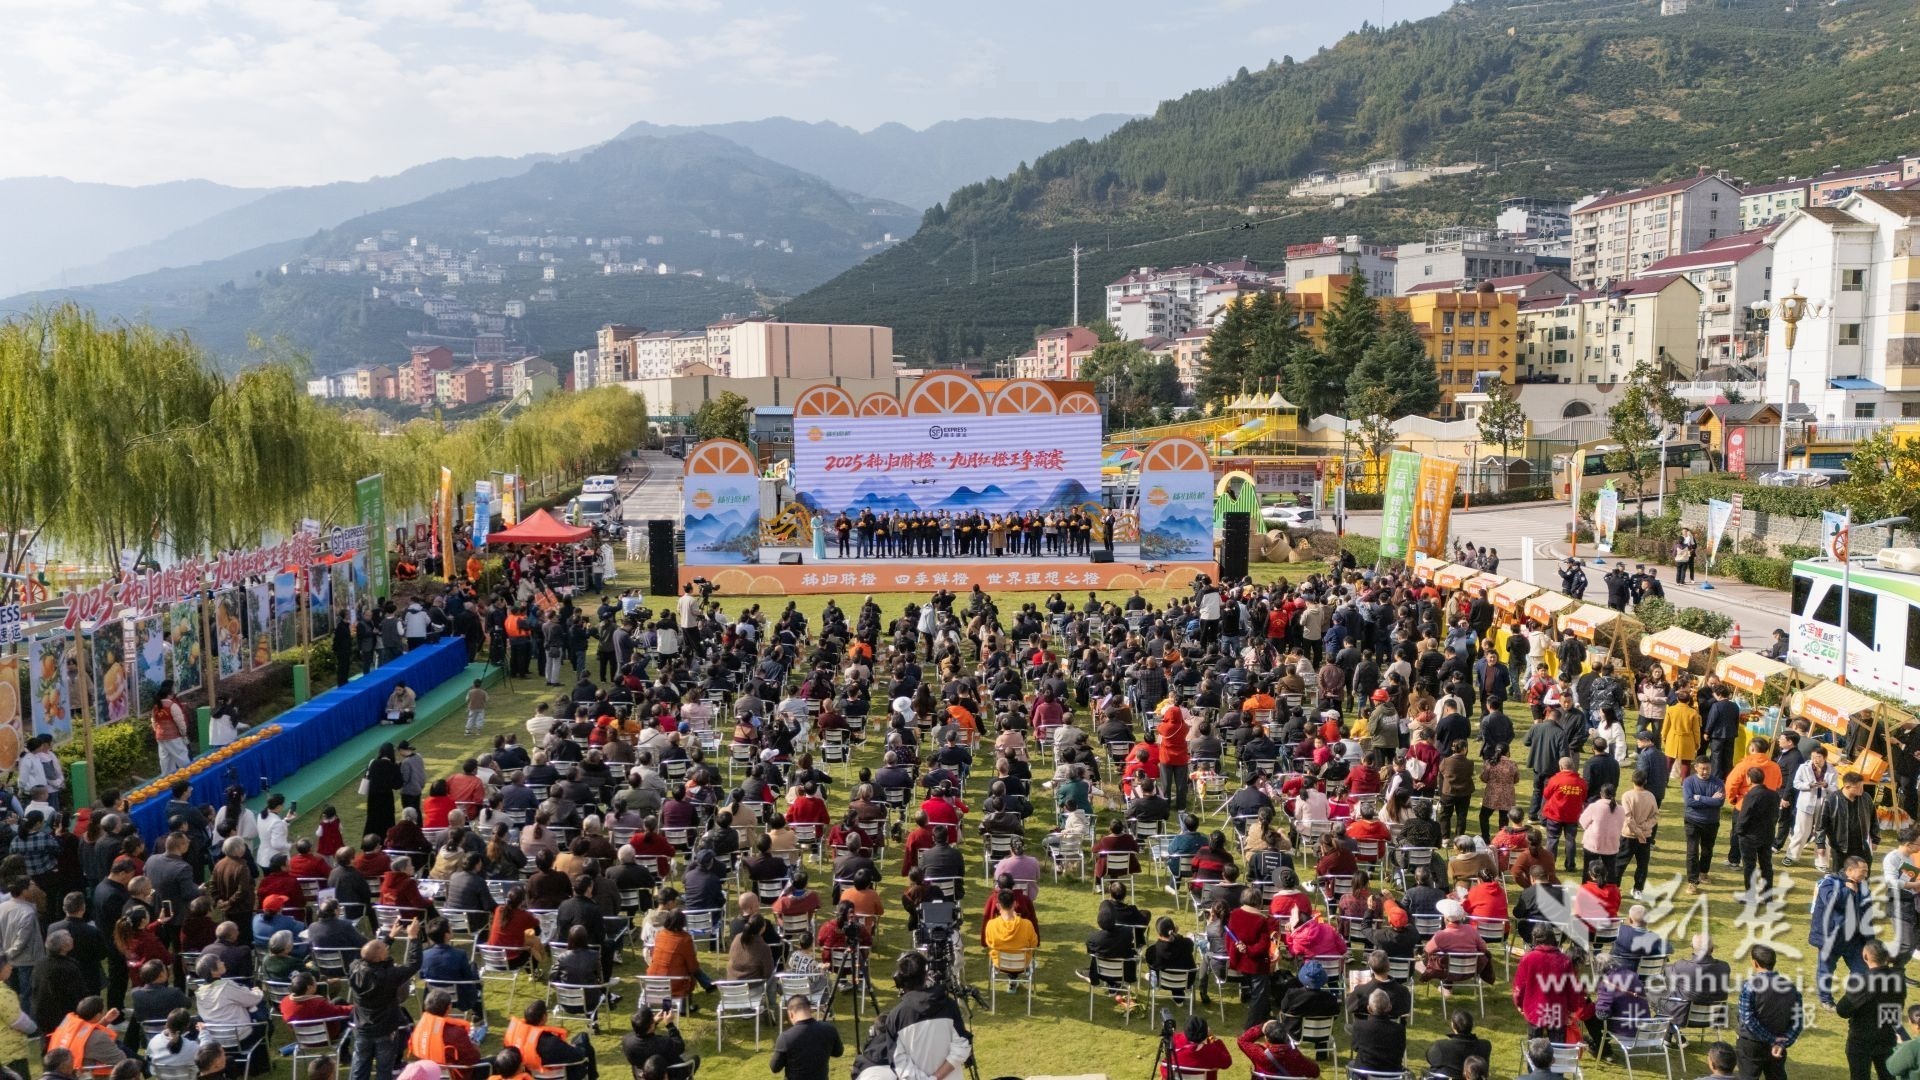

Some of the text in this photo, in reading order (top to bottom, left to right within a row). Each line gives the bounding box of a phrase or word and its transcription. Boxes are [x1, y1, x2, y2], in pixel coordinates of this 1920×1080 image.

[801, 571, 1101, 587] 秭归脐橙 四季鲜橙 世界理想之橙
